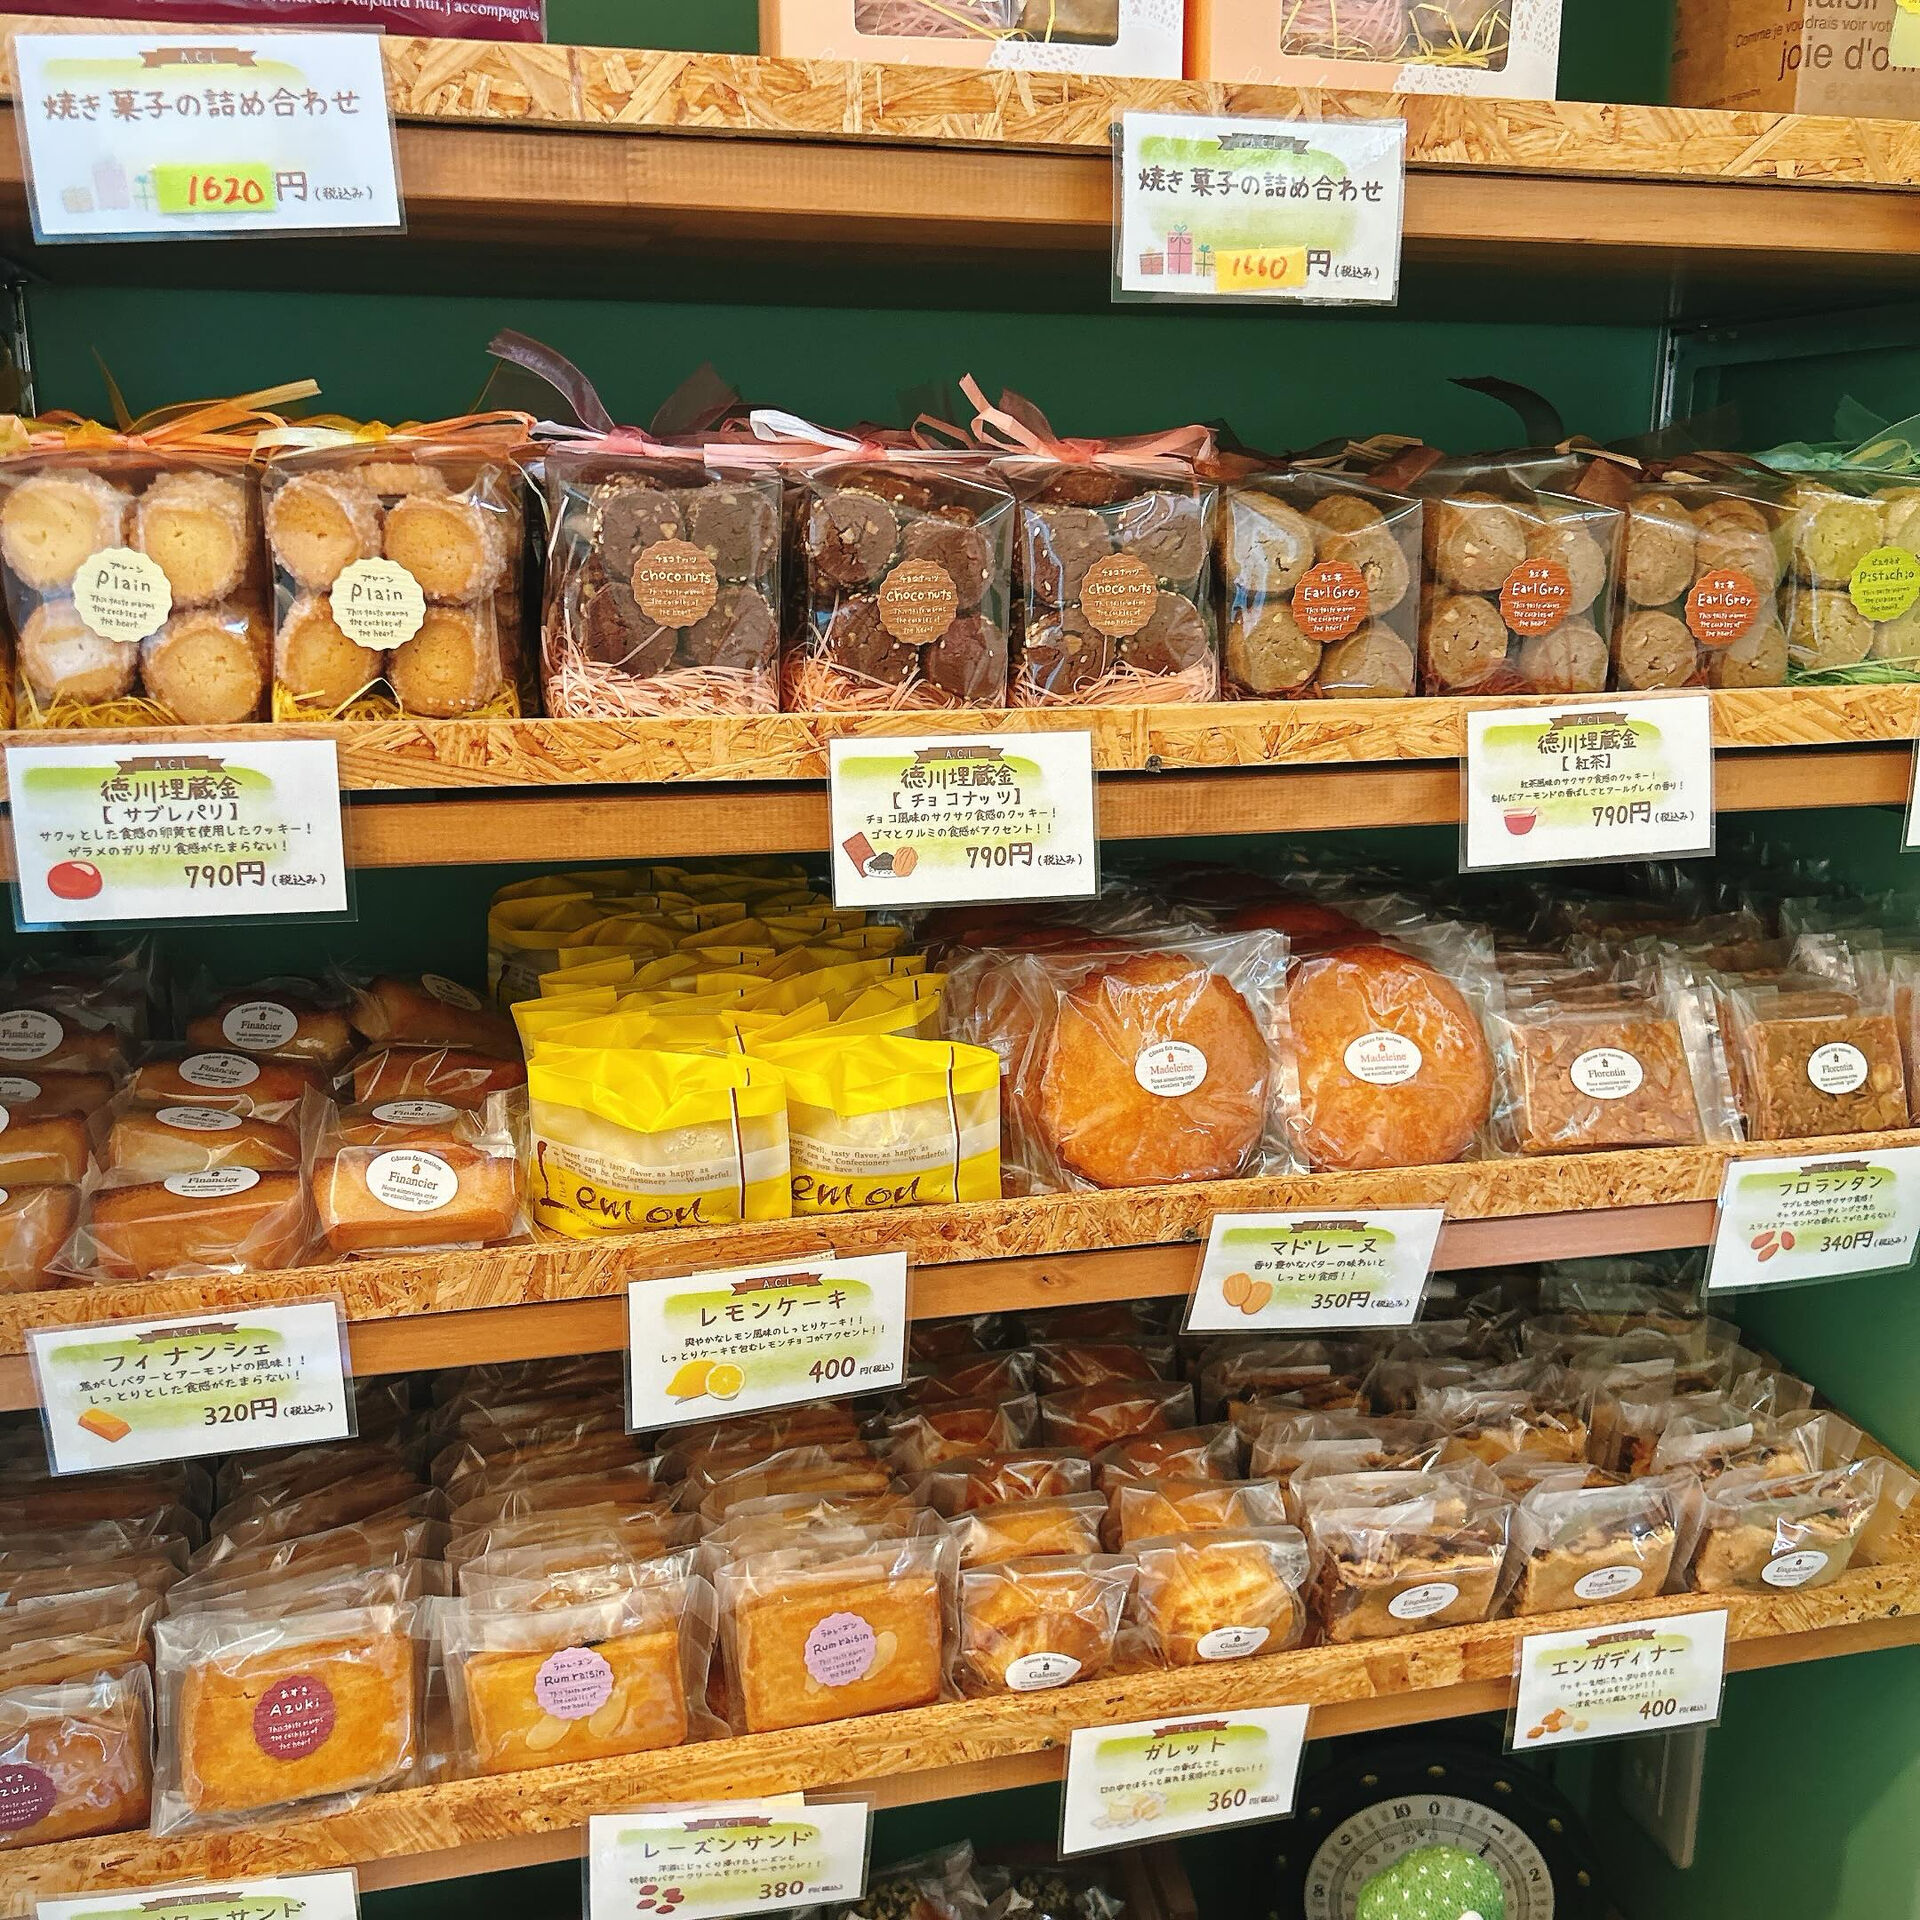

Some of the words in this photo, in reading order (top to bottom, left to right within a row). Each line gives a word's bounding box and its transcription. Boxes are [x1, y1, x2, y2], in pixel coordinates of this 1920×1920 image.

[1777, 36, 1834, 81] joie
[43, 87, 361, 122] 焼き菓子の詰め合わせ
[1138, 165, 1384, 202] 焼き菓子の詰め合わせ
[97, 569, 151, 593] Plain
[351, 583, 403, 602] Plain
[1304, 586, 1330, 601] Earl
[1333, 585, 1361, 599] Grey
[1512, 581, 1537, 597] Earl
[1539, 582, 1565, 597] Grey
[1697, 592, 1723, 608] Earl
[1725, 593, 1752, 607] Grey
[1537, 728, 1640, 755] 徳川埋蔵金
[944, 749, 975, 760] A.C.L
[1561, 753, 1612, 772] 【紅茶】
[900, 763, 1018, 790] 徳川埋蔵金
[101, 776, 242, 803] 徳川埋蔵金
[1592, 800, 1652, 828] 790円
[965, 842, 1033, 869] 790円
[184, 860, 266, 889] 790円
[388, 1171, 439, 1190] Financier
[1778, 1176, 1883, 1197] フロランタン
[1270, 1237, 1378, 1257] マドレーヌ
[1820, 1230, 1874, 1252] 340円
[762, 1277, 793, 1290] A.C.L
[700, 1289, 847, 1327] レモンケーキ
[1311, 1291, 1371, 1310] 350円
[102, 1341, 271, 1373] フィナンシェ
[808, 1356, 856, 1384] 400
[204, 1397, 279, 1426] 320円
[1551, 1644, 1686, 1677] エンガディナー
[269, 1697, 320, 1717] Azuki
[1639, 1698, 1678, 1720] 400
[1144, 1736, 1226, 1761] ガレット
[0, 1782, 38, 1797] zuki
[1207, 1788, 1247, 1812] 360
[643, 1830, 814, 1858] レーズンサンド
[758, 1880, 805, 1900] 380
